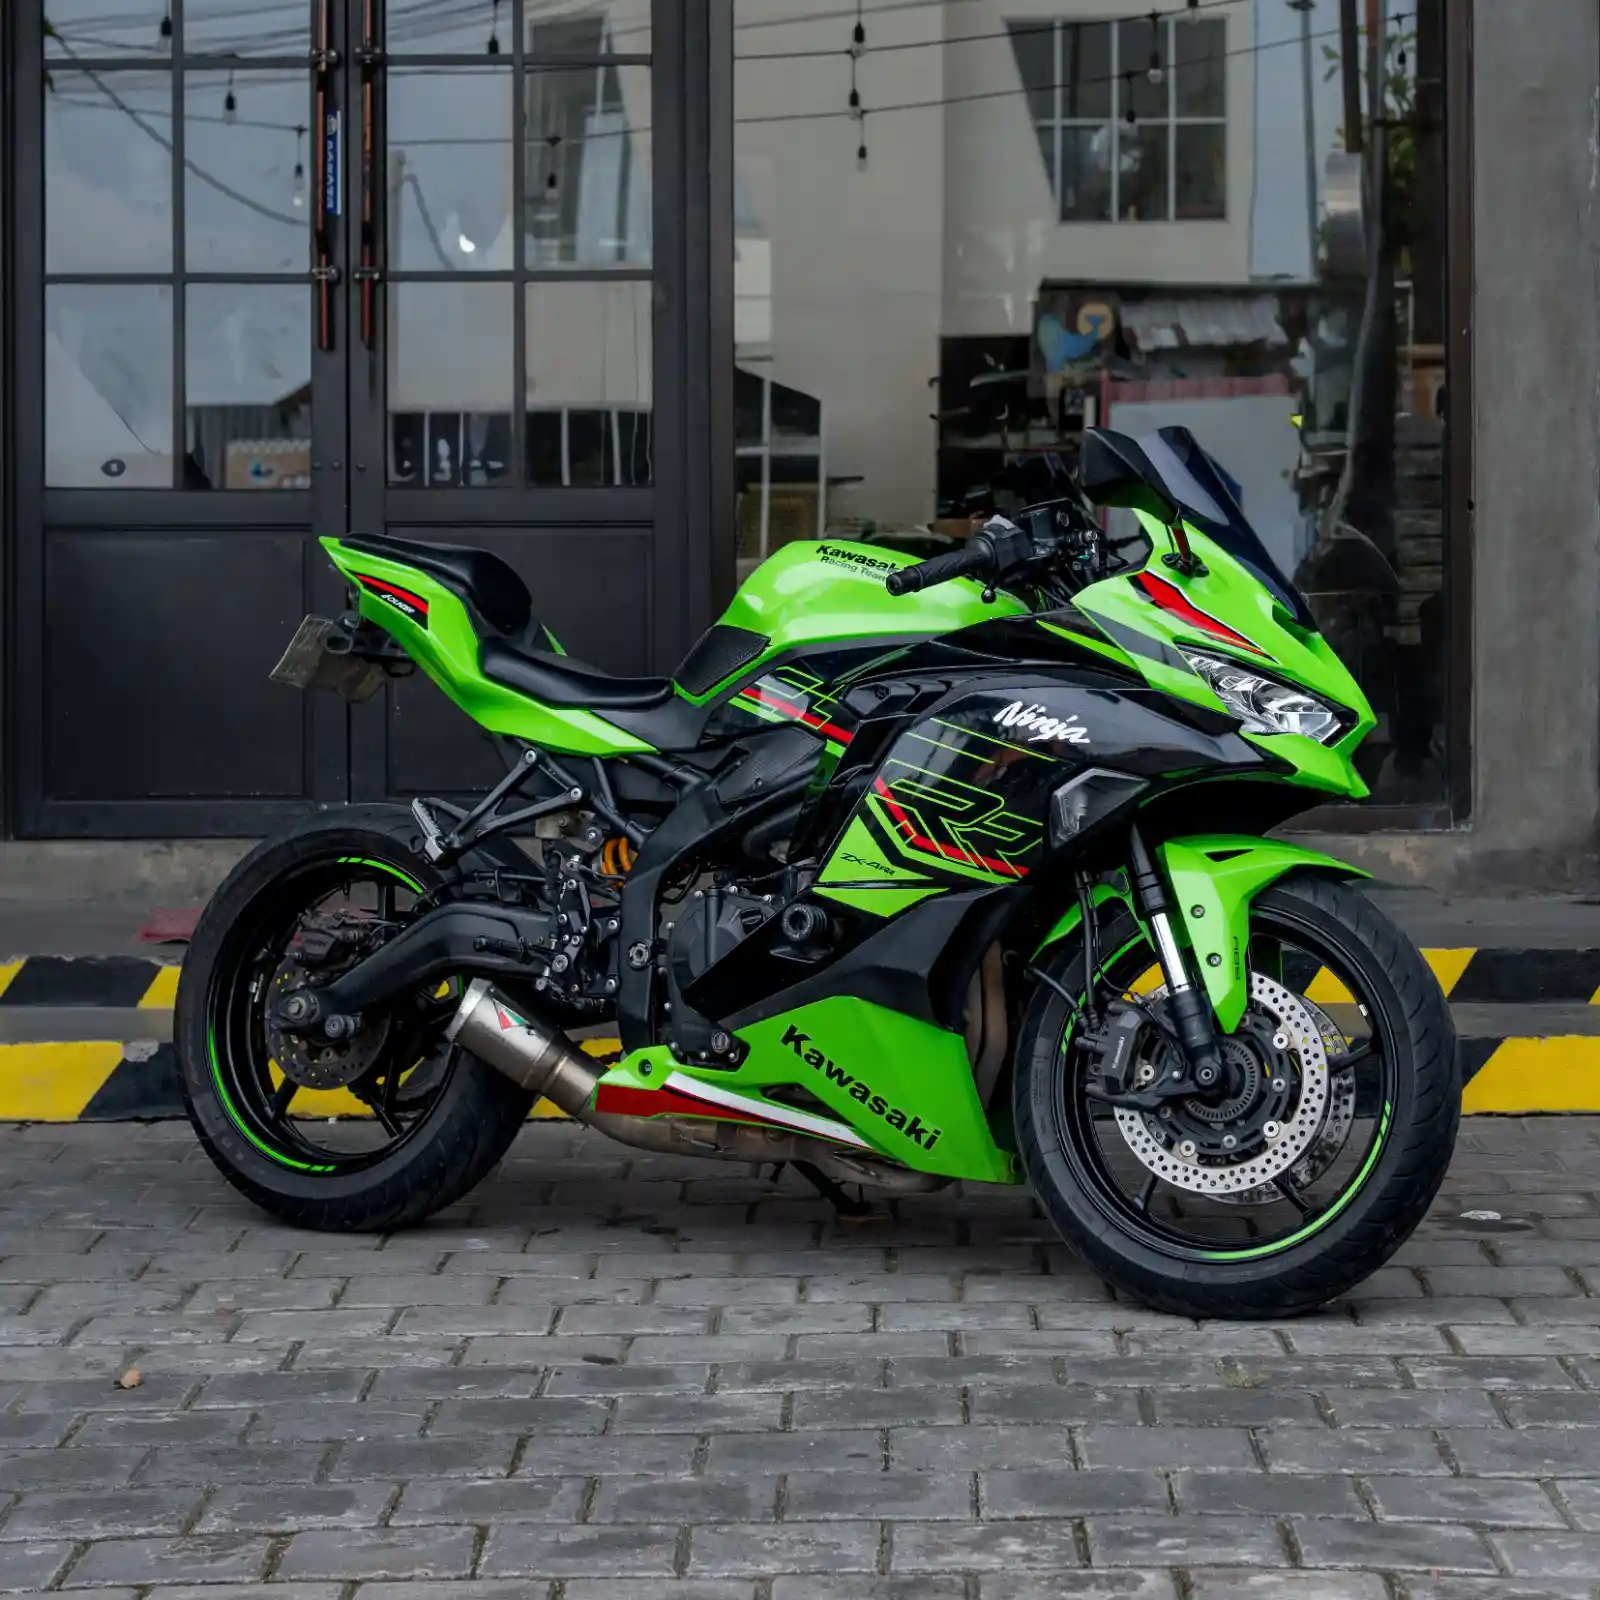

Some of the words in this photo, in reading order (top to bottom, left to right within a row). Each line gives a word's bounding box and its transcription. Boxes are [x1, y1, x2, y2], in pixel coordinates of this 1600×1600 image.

[816, 545, 902, 574] Kawasak
[820, 556, 858, 572] Racing
[992, 701, 1091, 743] Ninja
[780, 1024, 942, 1151] Kawasaki
